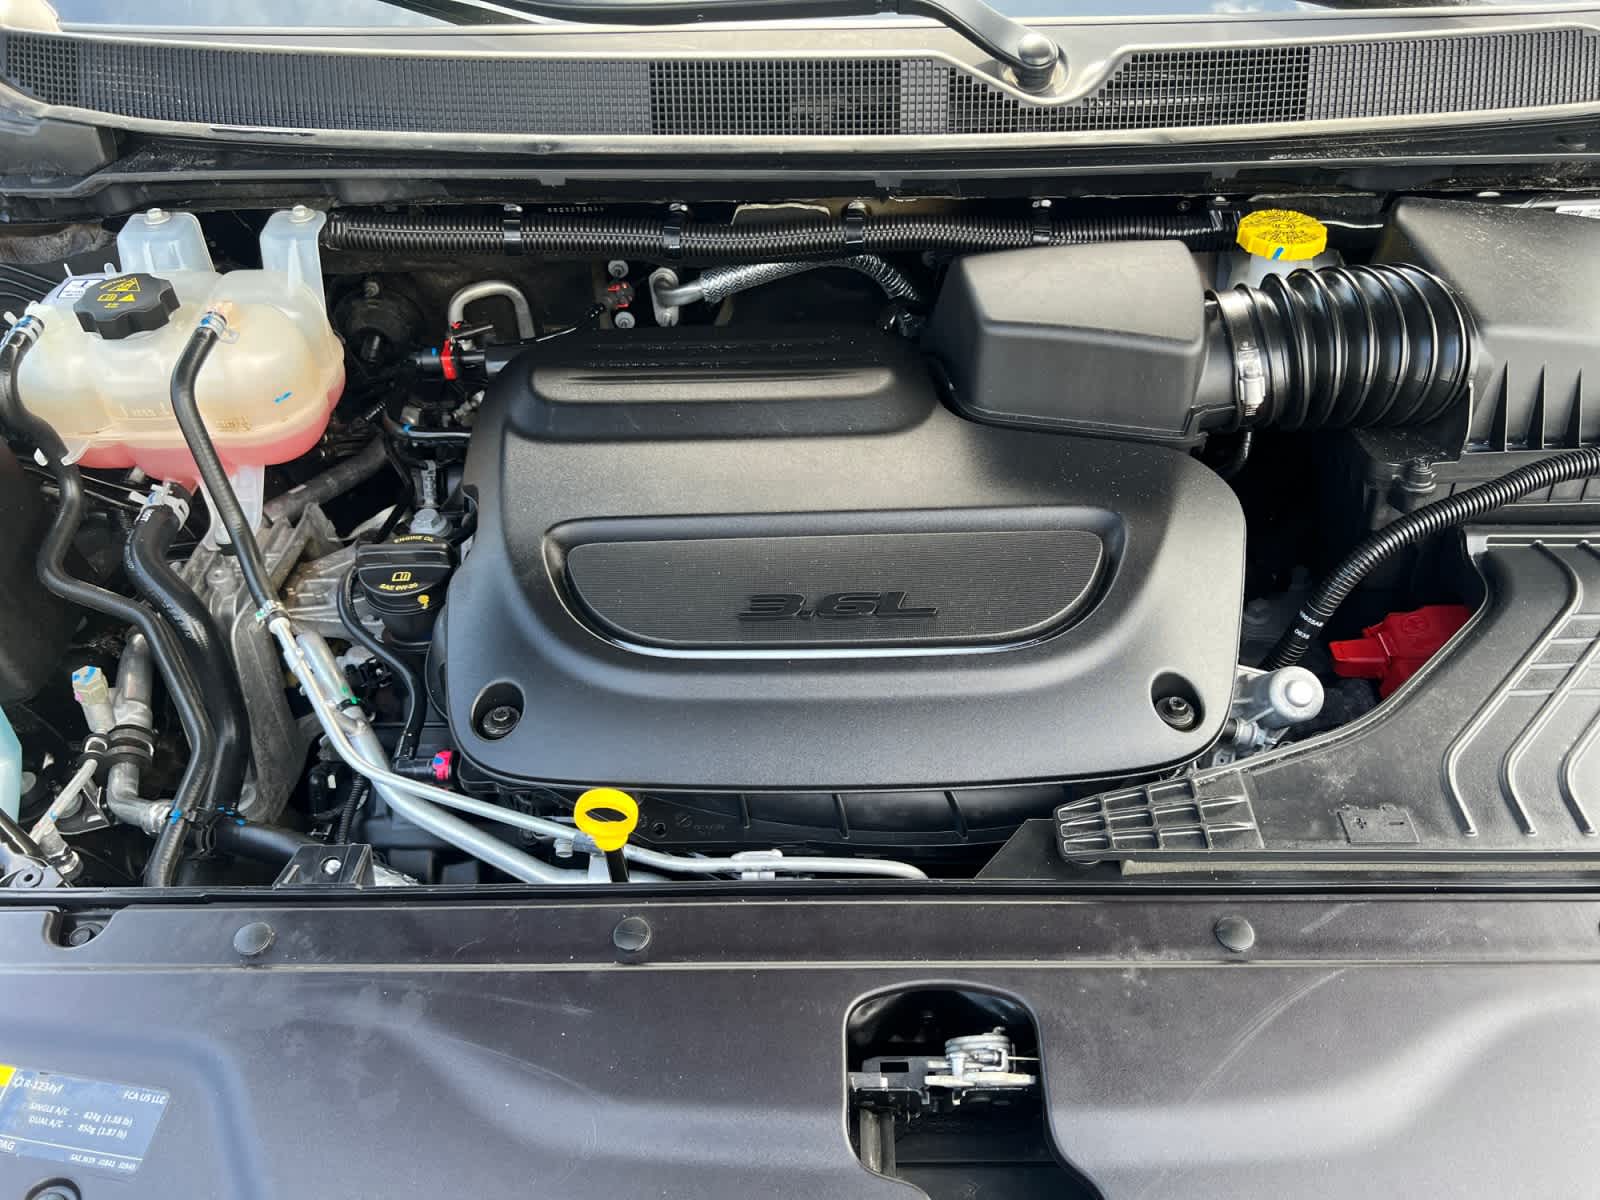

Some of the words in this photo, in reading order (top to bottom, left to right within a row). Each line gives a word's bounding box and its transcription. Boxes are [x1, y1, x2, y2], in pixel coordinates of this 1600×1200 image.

[738, 591, 938, 620] 3.6L
[123, 1090, 139, 1100] FCA
[139, 1093, 151, 1103] US
[151, 1095, 167, 1106] LLC
[28, 1115, 48, 1126] DUAL
